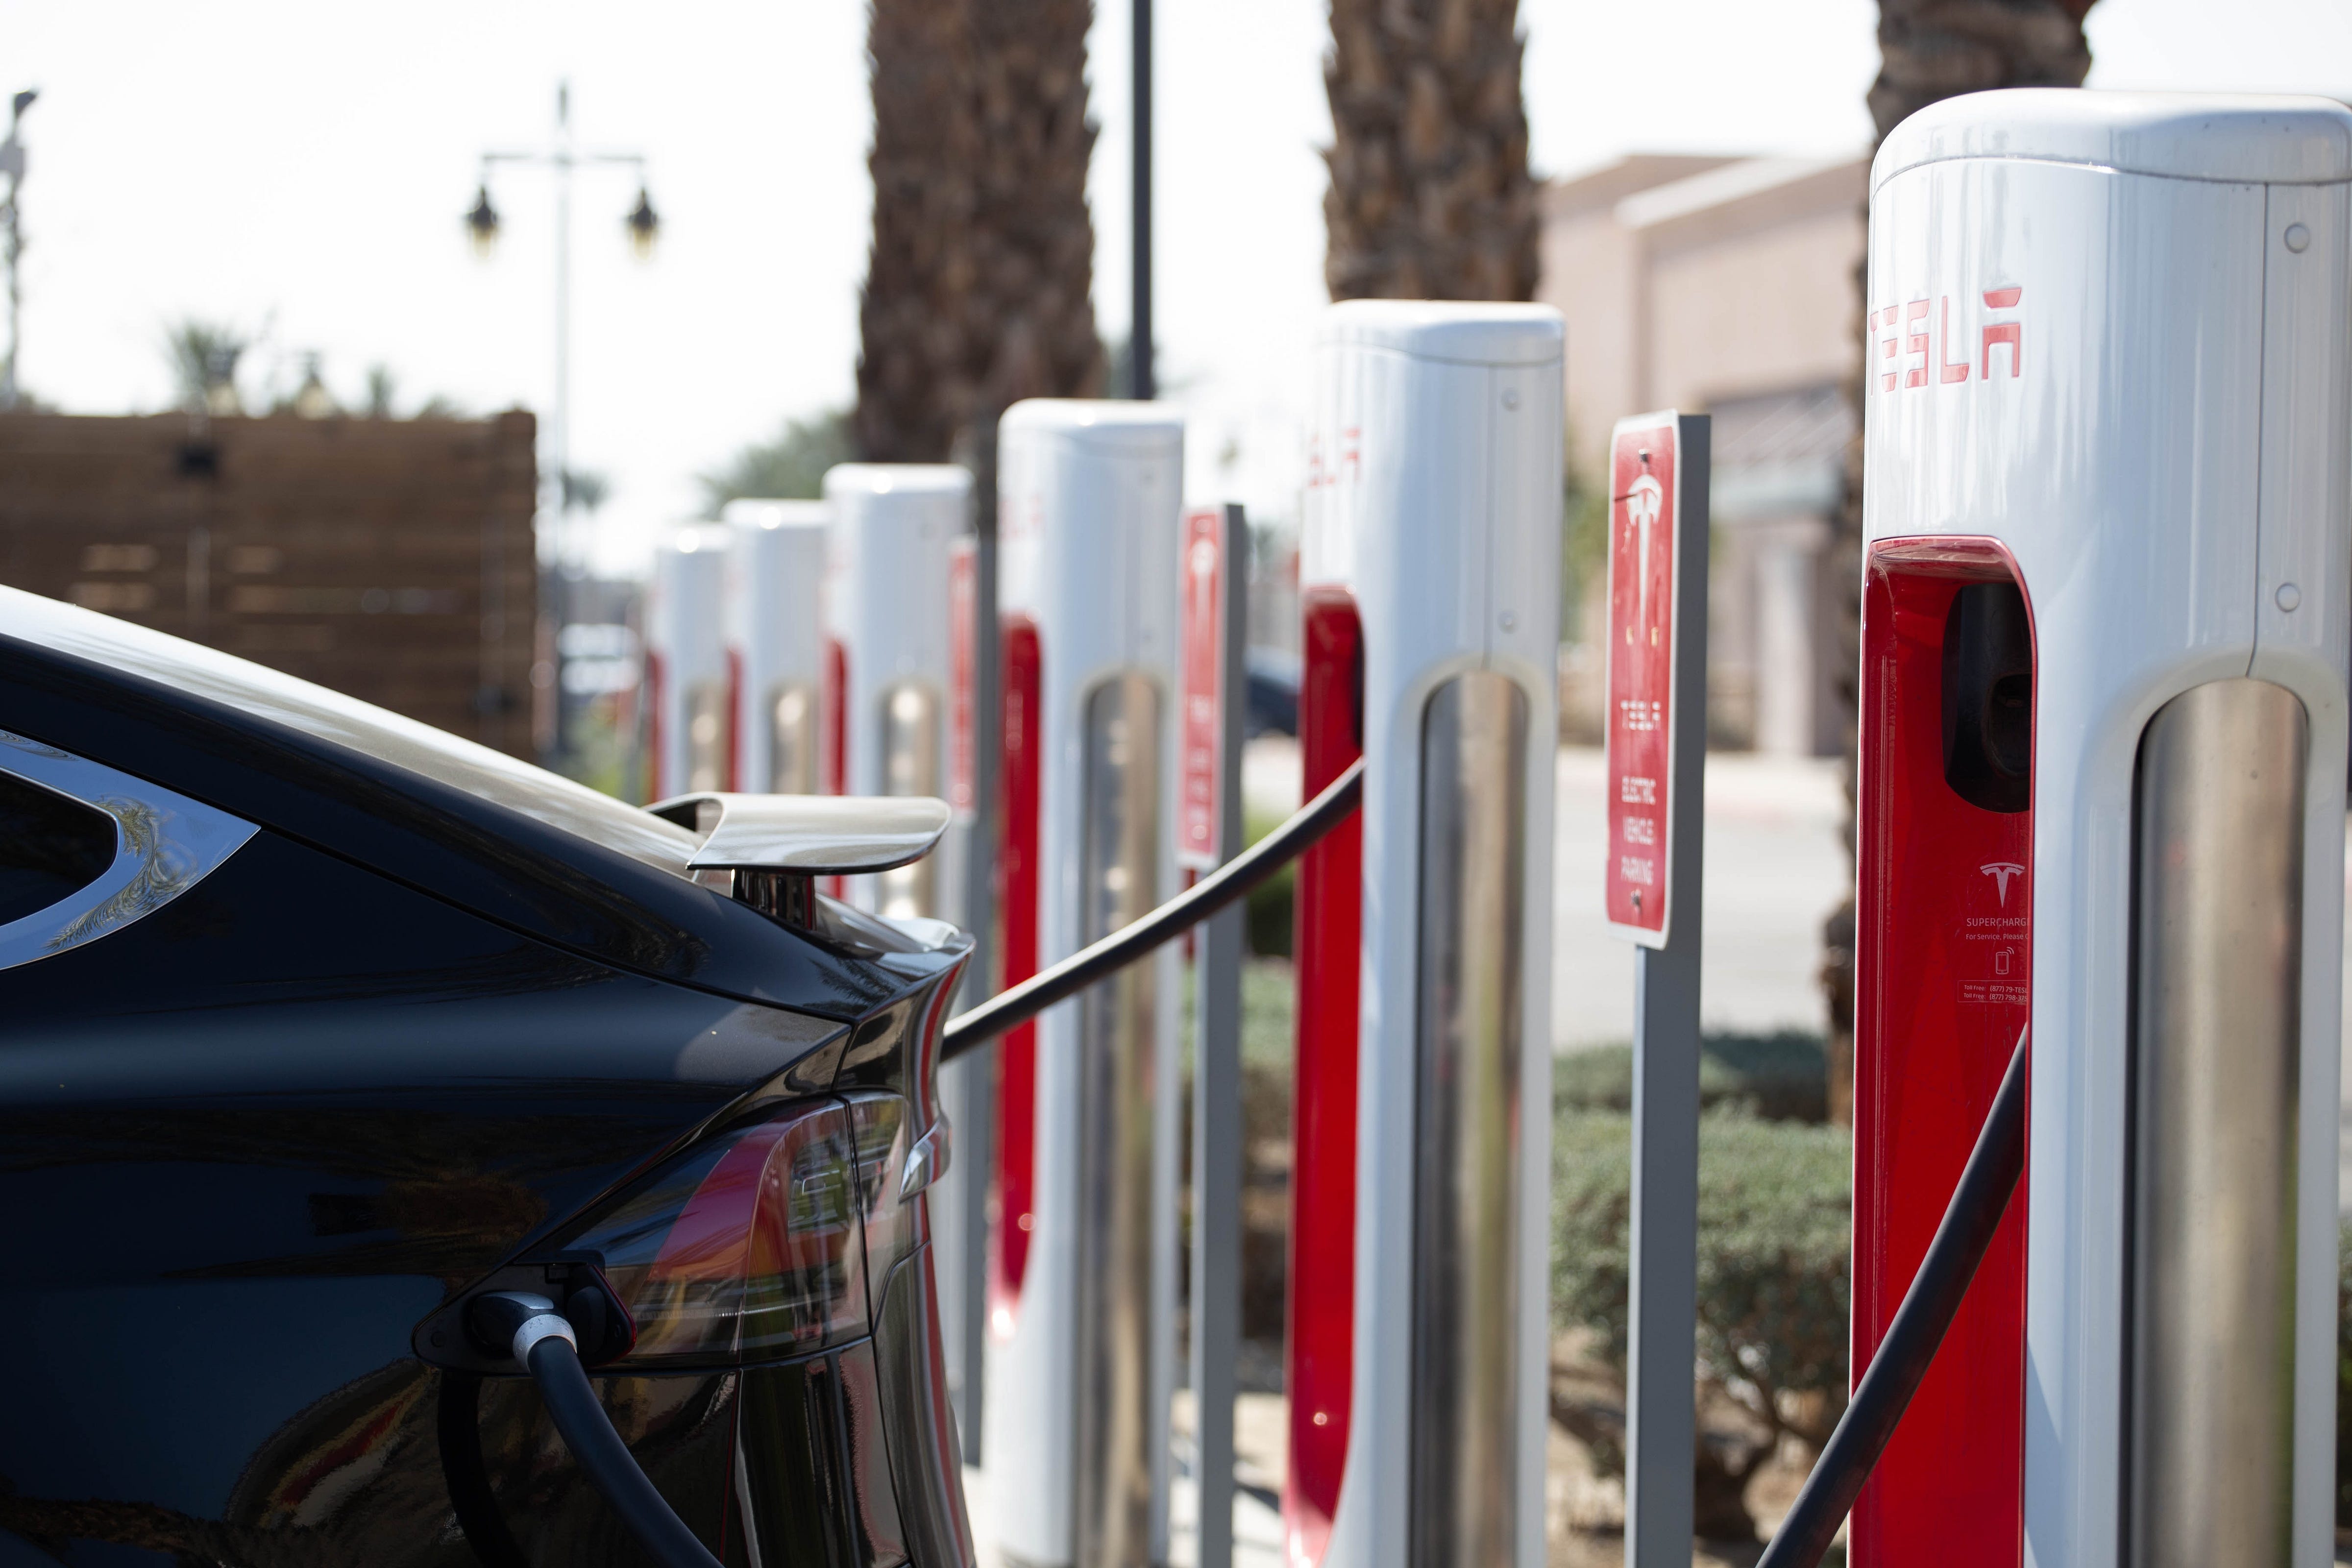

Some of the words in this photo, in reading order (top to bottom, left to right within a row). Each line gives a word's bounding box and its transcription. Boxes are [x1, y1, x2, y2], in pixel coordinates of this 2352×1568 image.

[1870, 287, 2022, 395] TESLA
[1620, 700, 1661, 731] TESLA
[1966, 917, 2029, 927] SUPERCHARG
